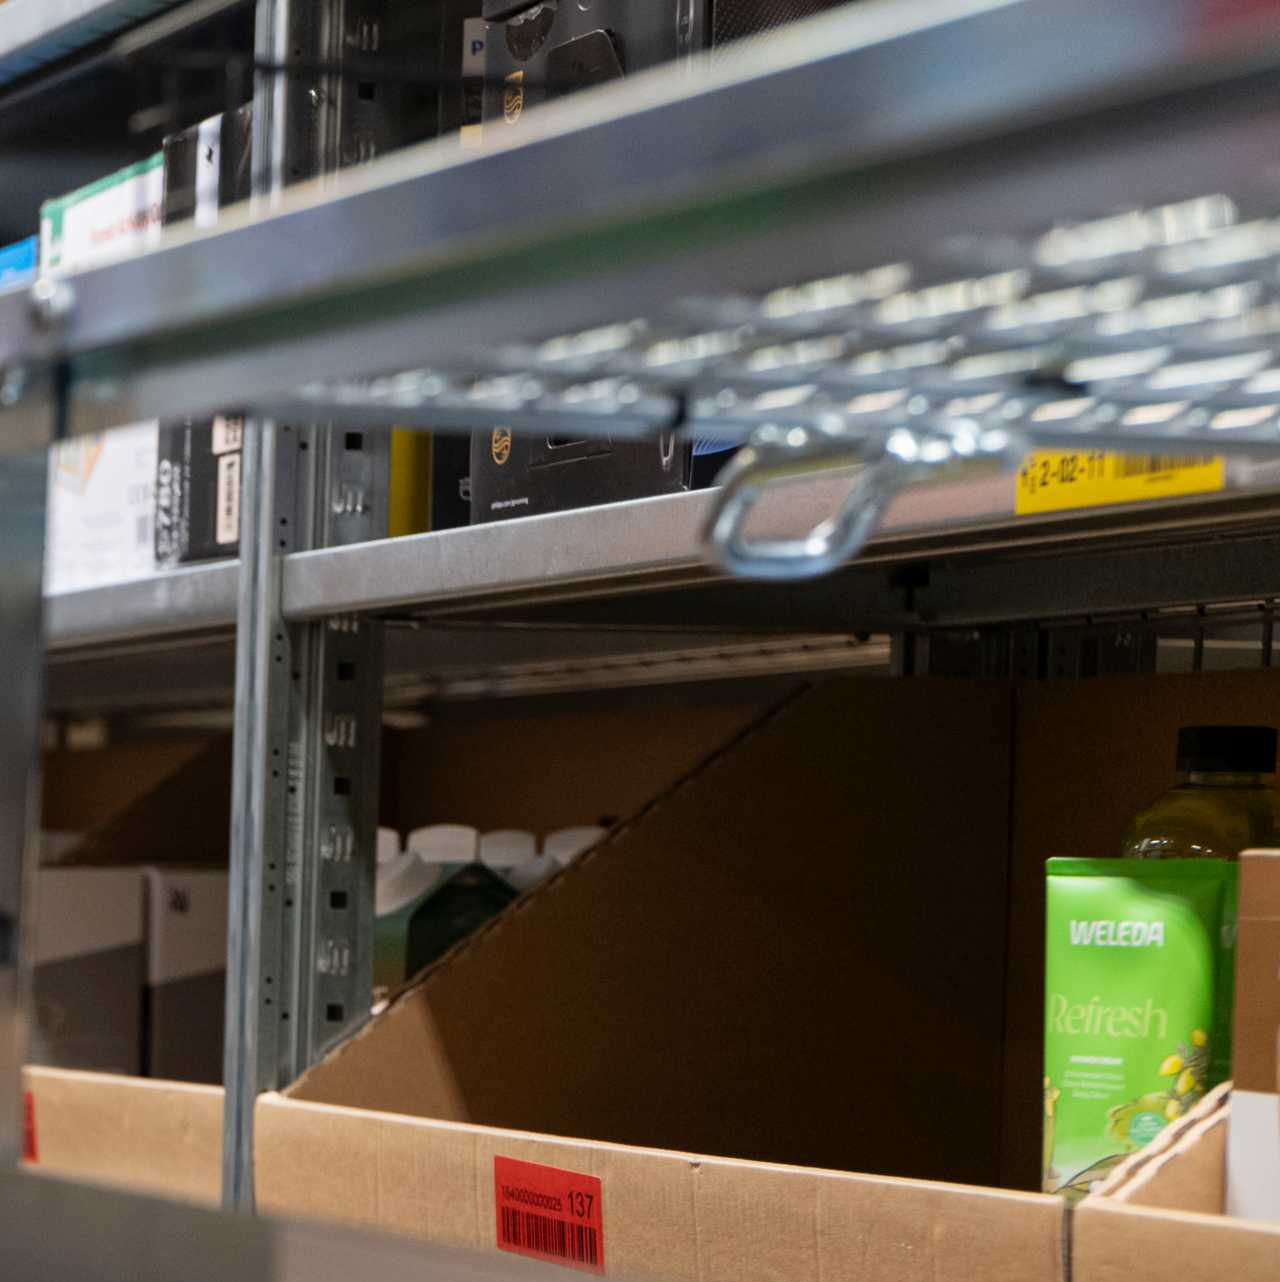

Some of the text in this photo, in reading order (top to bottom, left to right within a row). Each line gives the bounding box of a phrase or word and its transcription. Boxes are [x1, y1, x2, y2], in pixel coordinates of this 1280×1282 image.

[1070, 920, 1165, 947] WELEDA
[1049, 994, 1167, 1039] Refresh
[567, 1190, 594, 1218] 137
